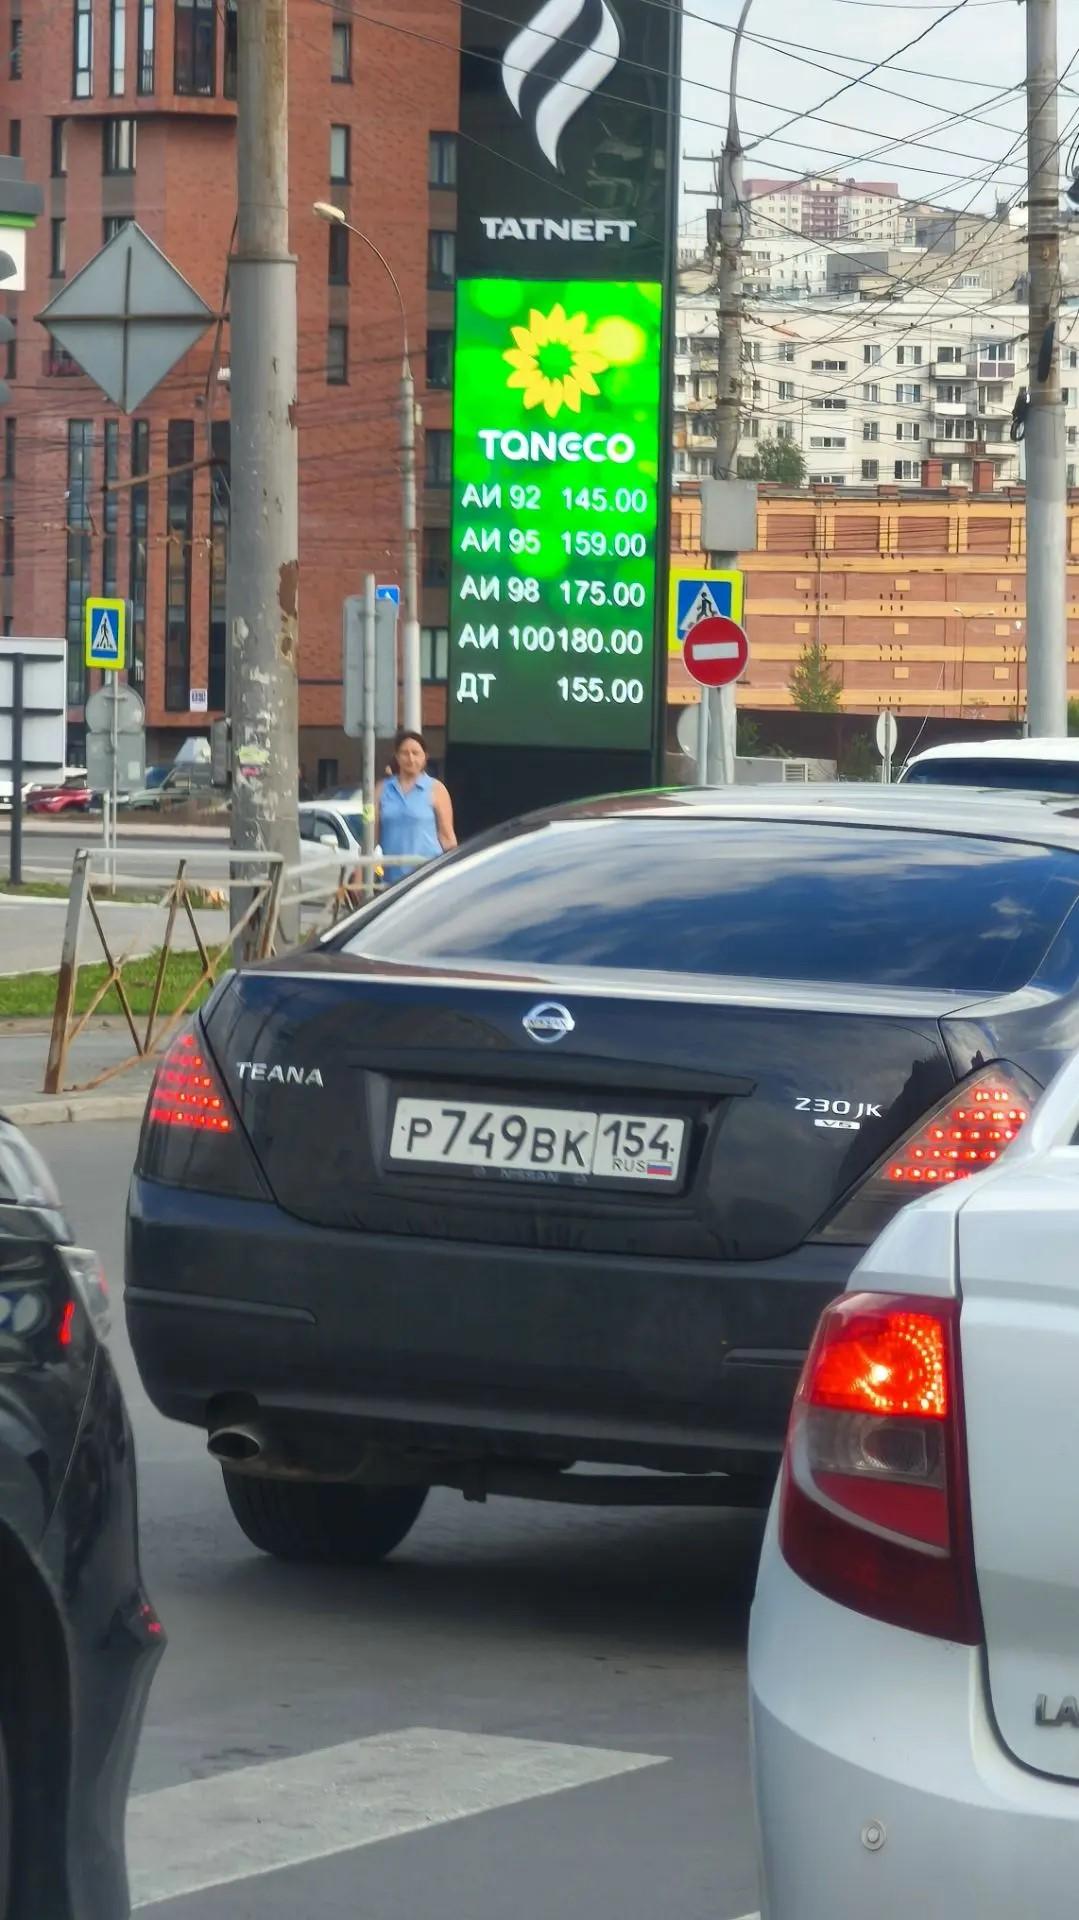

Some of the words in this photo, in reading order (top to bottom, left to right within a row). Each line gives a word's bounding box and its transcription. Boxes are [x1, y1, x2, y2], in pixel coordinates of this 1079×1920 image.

[479, 216, 637, 242] TATNEFT
[461, 483, 501, 508] АИ
[509, 485, 541, 510] 92
[562, 487, 647, 512] 145.00
[460, 527, 501, 552] АИ
[508, 528, 541, 555] 95
[561, 531, 646, 557] 159.00
[459, 575, 500, 601] АИ
[507, 576, 540, 603] 98
[560, 580, 645, 607] 175.00
[458, 623, 499, 649] АИ
[509, 625, 555, 652] 100
[557, 627, 643, 655] 180.00
[456, 672, 496, 703] ДТ
[557, 676, 644, 704] 155.00
[236, 1061, 324, 1088] TEANA
[603, 1120, 669, 1160] 154
[612, 1158, 646, 1173] RUS
